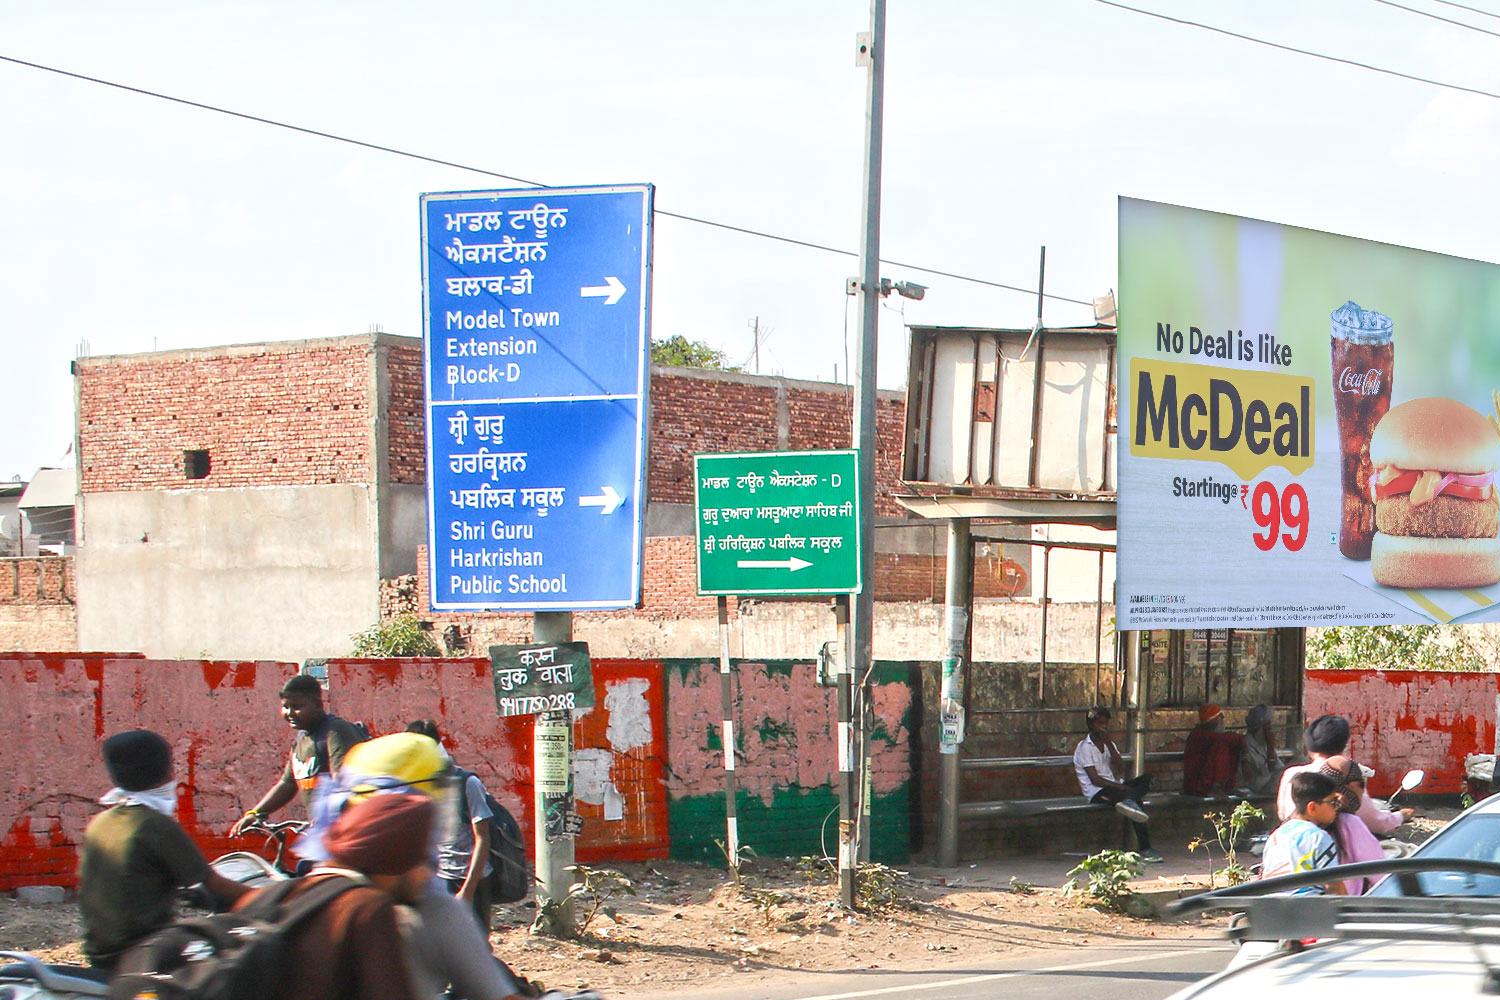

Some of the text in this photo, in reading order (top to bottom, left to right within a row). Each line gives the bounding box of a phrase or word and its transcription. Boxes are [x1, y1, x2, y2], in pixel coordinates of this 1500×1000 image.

[445, 203, 569, 239] ਮਾਡਲ ਟਾਊਨ
[446, 268, 534, 297] ਬਲਾਕ-ਡੀ
[446, 308, 560, 330] Model Town
[447, 336, 537, 357] Extension
[1157, 322, 1292, 367] No Deal is like
[447, 363, 521, 384] Block-D
[1135, 370, 1310, 457] McDeal
[474, 415, 505, 445] ਗੁਰੂ
[702, 477, 730, 489] ਮਾਡਲ
[831, 473, 842, 488] D
[450, 483, 565, 517] ਪਬਲਿਕ ਸਕੂਲ
[839, 501, 853, 517] ਜੀ
[451, 520, 534, 541] Shri Guru
[768, 534, 806, 550] ਪਬਲਿਕ
[451, 548, 543, 568] Harkrishan
[451, 573, 567, 594] Public School
